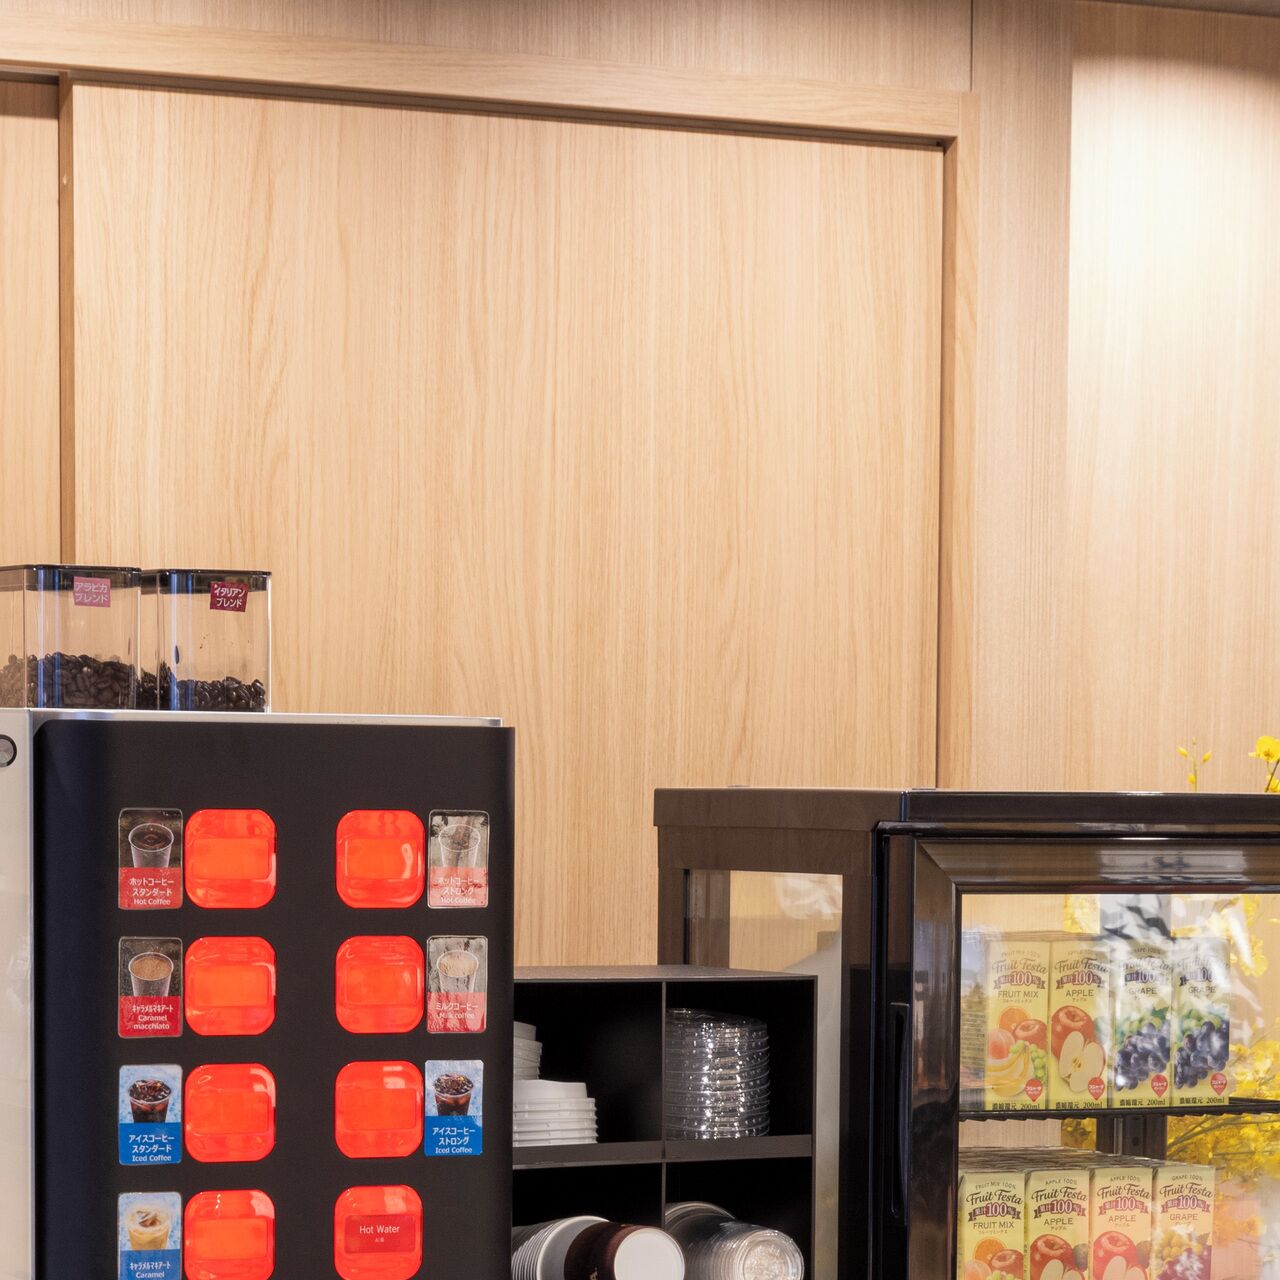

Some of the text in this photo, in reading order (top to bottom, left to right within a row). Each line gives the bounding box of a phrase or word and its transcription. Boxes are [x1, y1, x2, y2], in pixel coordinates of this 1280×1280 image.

[76, 582, 108, 592] アラビカ
[213, 584, 246, 597] イタリアン
[75, 593, 108, 604] ブレンド
[216, 599, 243, 608] ブレンド
[129, 877, 174, 886] ホットコーヒー
[132, 888, 173, 897] スタンダード
[992, 958, 1048, 975] Fruit Festa
[1054, 960, 1081, 974] Fruit
[998, 990, 1039, 999] FRUIT MIX
[1065, 989, 1094, 998] APPLE
[435, 1002, 478, 1010] ミルクコーヒー
[1146, 1098, 1166, 1106] 200ml
[1206, 1095, 1225, 1104] 200ml
[1020, 1102, 1040, 1110] 200ml
[1083, 1101, 1103, 1109] 200ml
[432, 1126, 476, 1136] アイスコーヒー
[129, 1134, 175, 1143] アイスコーヒー
[438, 1136, 470, 1146] ストロング
[132, 1144, 172, 1153] スタンダード
[435, 1146, 472, 1154] Iced Coffee
[1031, 1186, 1088, 1202] Fruit Festa
[1097, 1183, 1151, 1200] Fruit Festa
[1160, 1182, 1213, 1199] Fruit Festa
[966, 1189, 1023, 1206] Fruit Festa
[1043, 1217, 1074, 1226] APPLE
[1108, 1214, 1137, 1223] APPLE
[1169, 1213, 1199, 1221] GRAPE
[359, 1224, 400, 1234] Hot Water
[973, 1221, 1015, 1230] FRUIT MIX
[135, 1271, 165, 1279] Caramel
